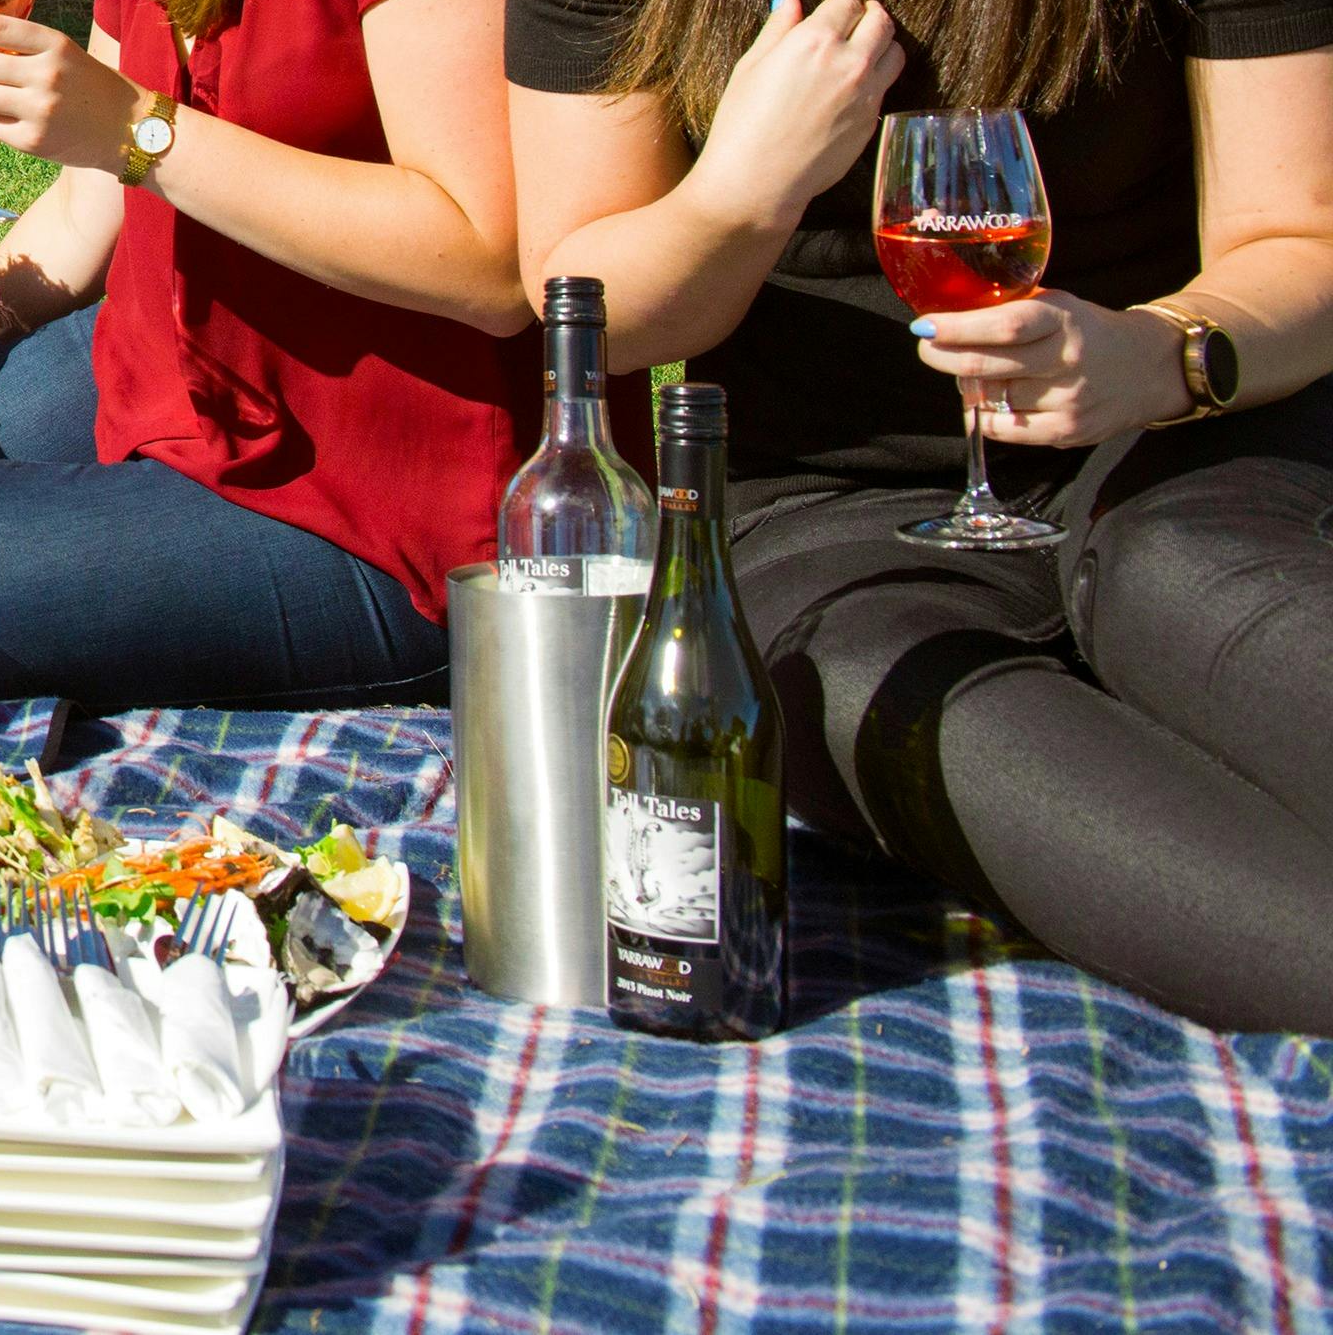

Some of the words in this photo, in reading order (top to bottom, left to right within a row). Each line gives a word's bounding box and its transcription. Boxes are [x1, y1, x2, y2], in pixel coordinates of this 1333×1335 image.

[913, 213, 1023, 231] YARRAWOOD
[520, 558, 570, 577] Tales
[611, 787, 639, 807] Tall
[643, 795, 702, 822] Tales
[665, 988, 693, 1004] Noir
